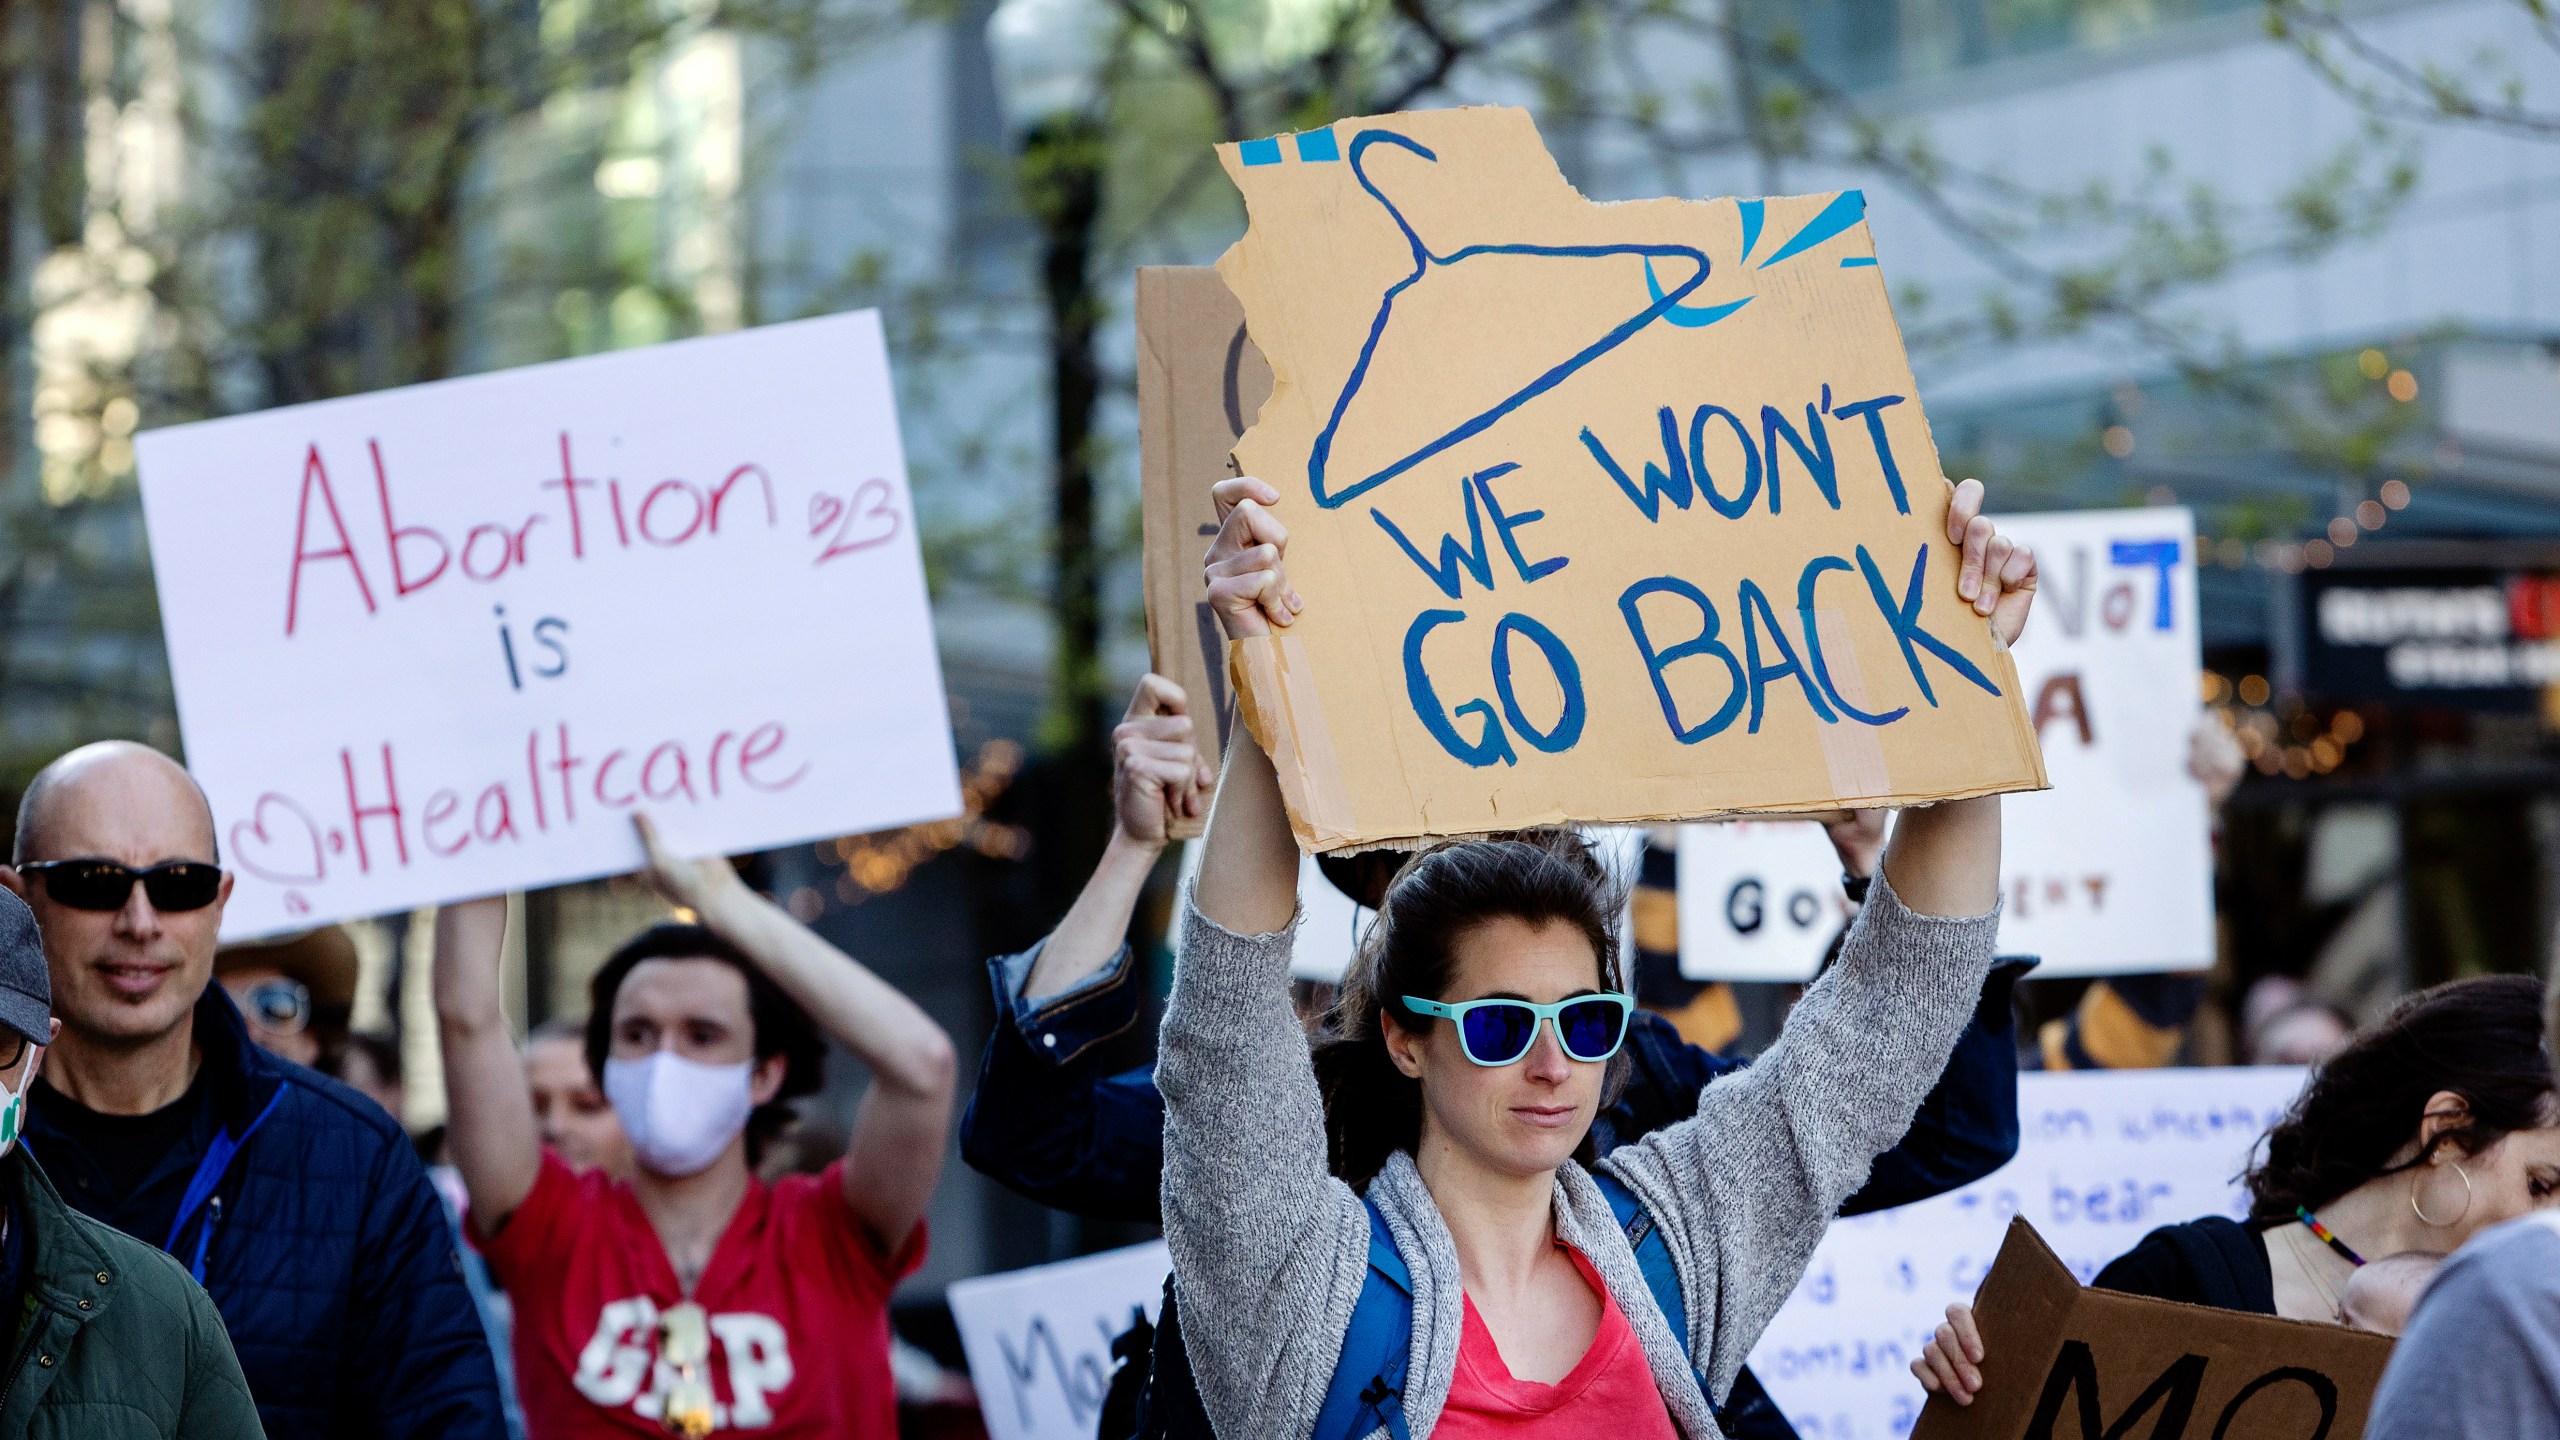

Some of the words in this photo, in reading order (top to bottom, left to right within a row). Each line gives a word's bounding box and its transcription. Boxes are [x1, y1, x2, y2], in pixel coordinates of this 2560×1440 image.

[286, 431, 778, 637] Abortion
[1370, 462, 1570, 599] WE
[1578, 382, 1906, 523] WON'T
[493, 604, 572, 691] is
[1402, 607, 1587, 767] GO
[1618, 543, 2004, 745] BACK
[340, 722, 813, 876] Healtcare
